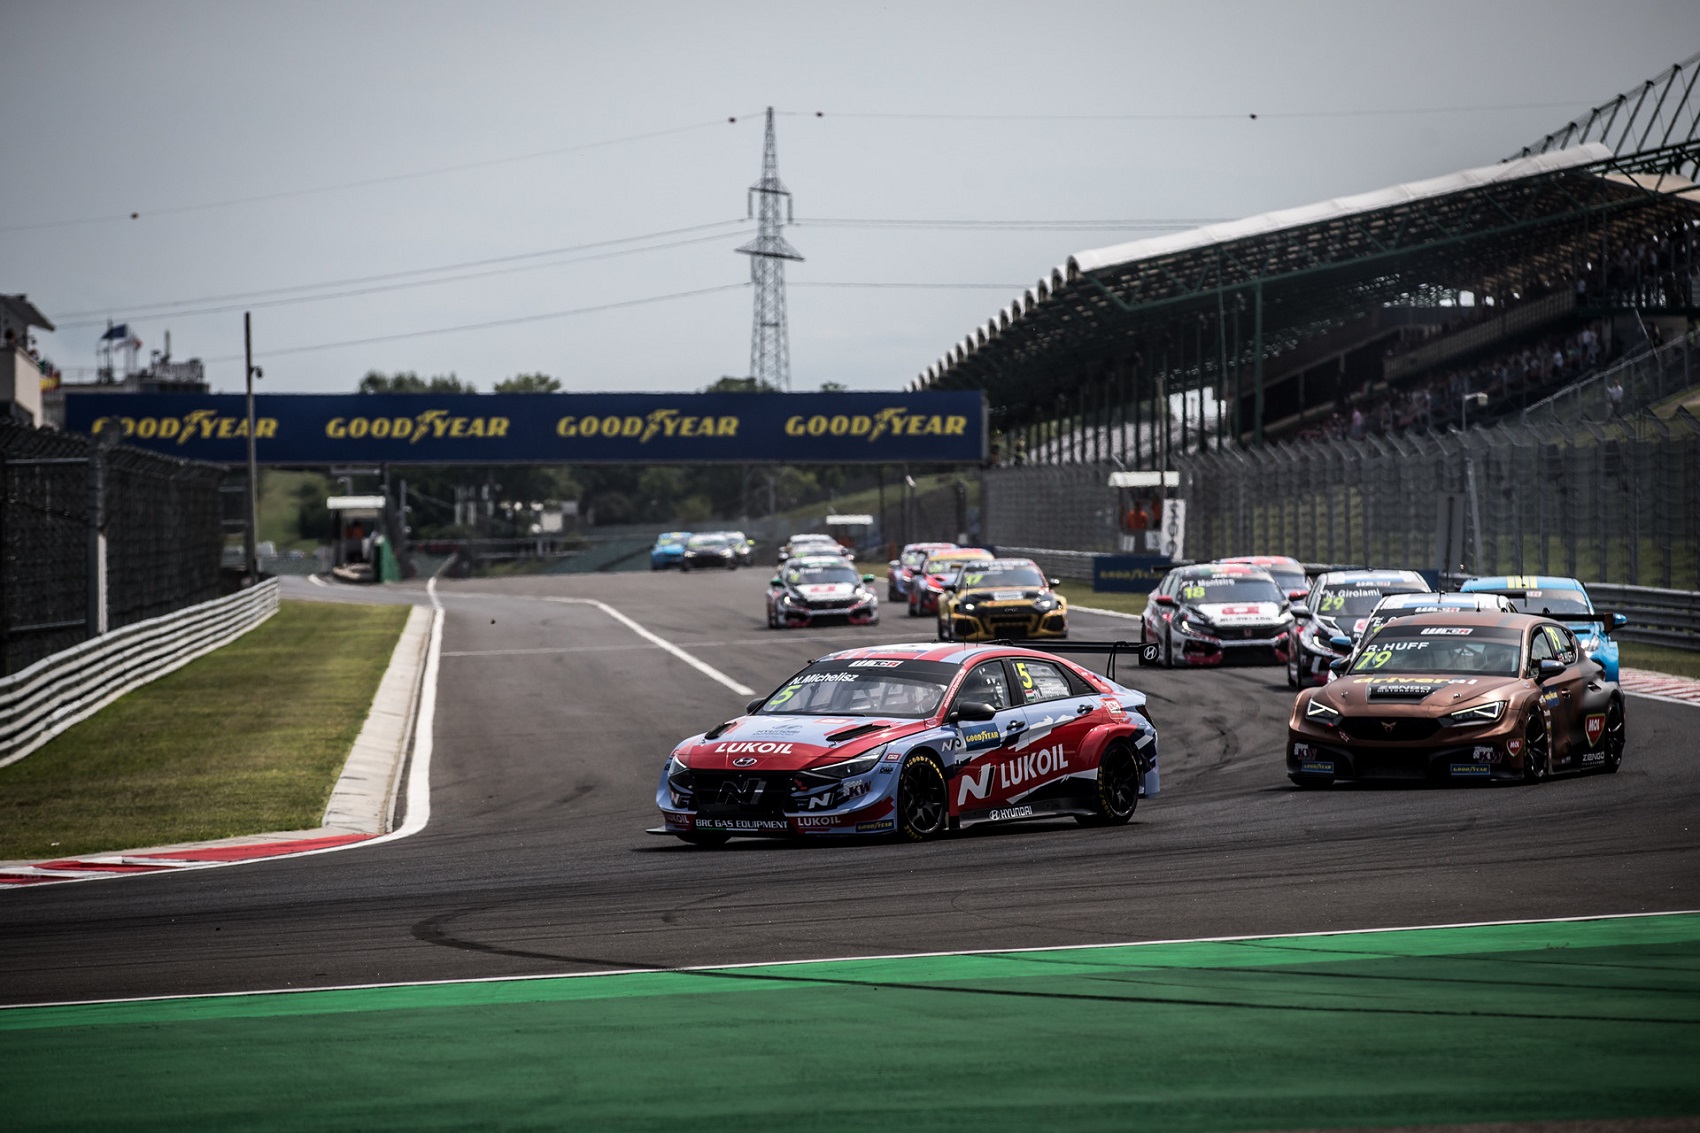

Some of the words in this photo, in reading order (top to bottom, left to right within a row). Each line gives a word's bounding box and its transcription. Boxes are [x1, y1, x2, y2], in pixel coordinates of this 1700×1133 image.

[1184, 586, 1206, 599] 18
[1338, 588, 1381, 598] Girolami
[1320, 597, 1345, 611] 29
[1354, 650, 1392, 670] 79
[1016, 662, 1034, 689] 5
[769, 684, 803, 706] 5
[966, 731, 999, 743] GOODYEAR
[714, 742, 793, 754] LUKOIL
[1000, 743, 1069, 789] LUKOIL
[1000, 805, 1033, 819] HYUNDAI
[695, 818, 713, 828] BRC
[714, 819, 734, 828] GAS
[736, 820, 788, 830] EQUIPMENT
[797, 816, 842, 828] LUKOIL
